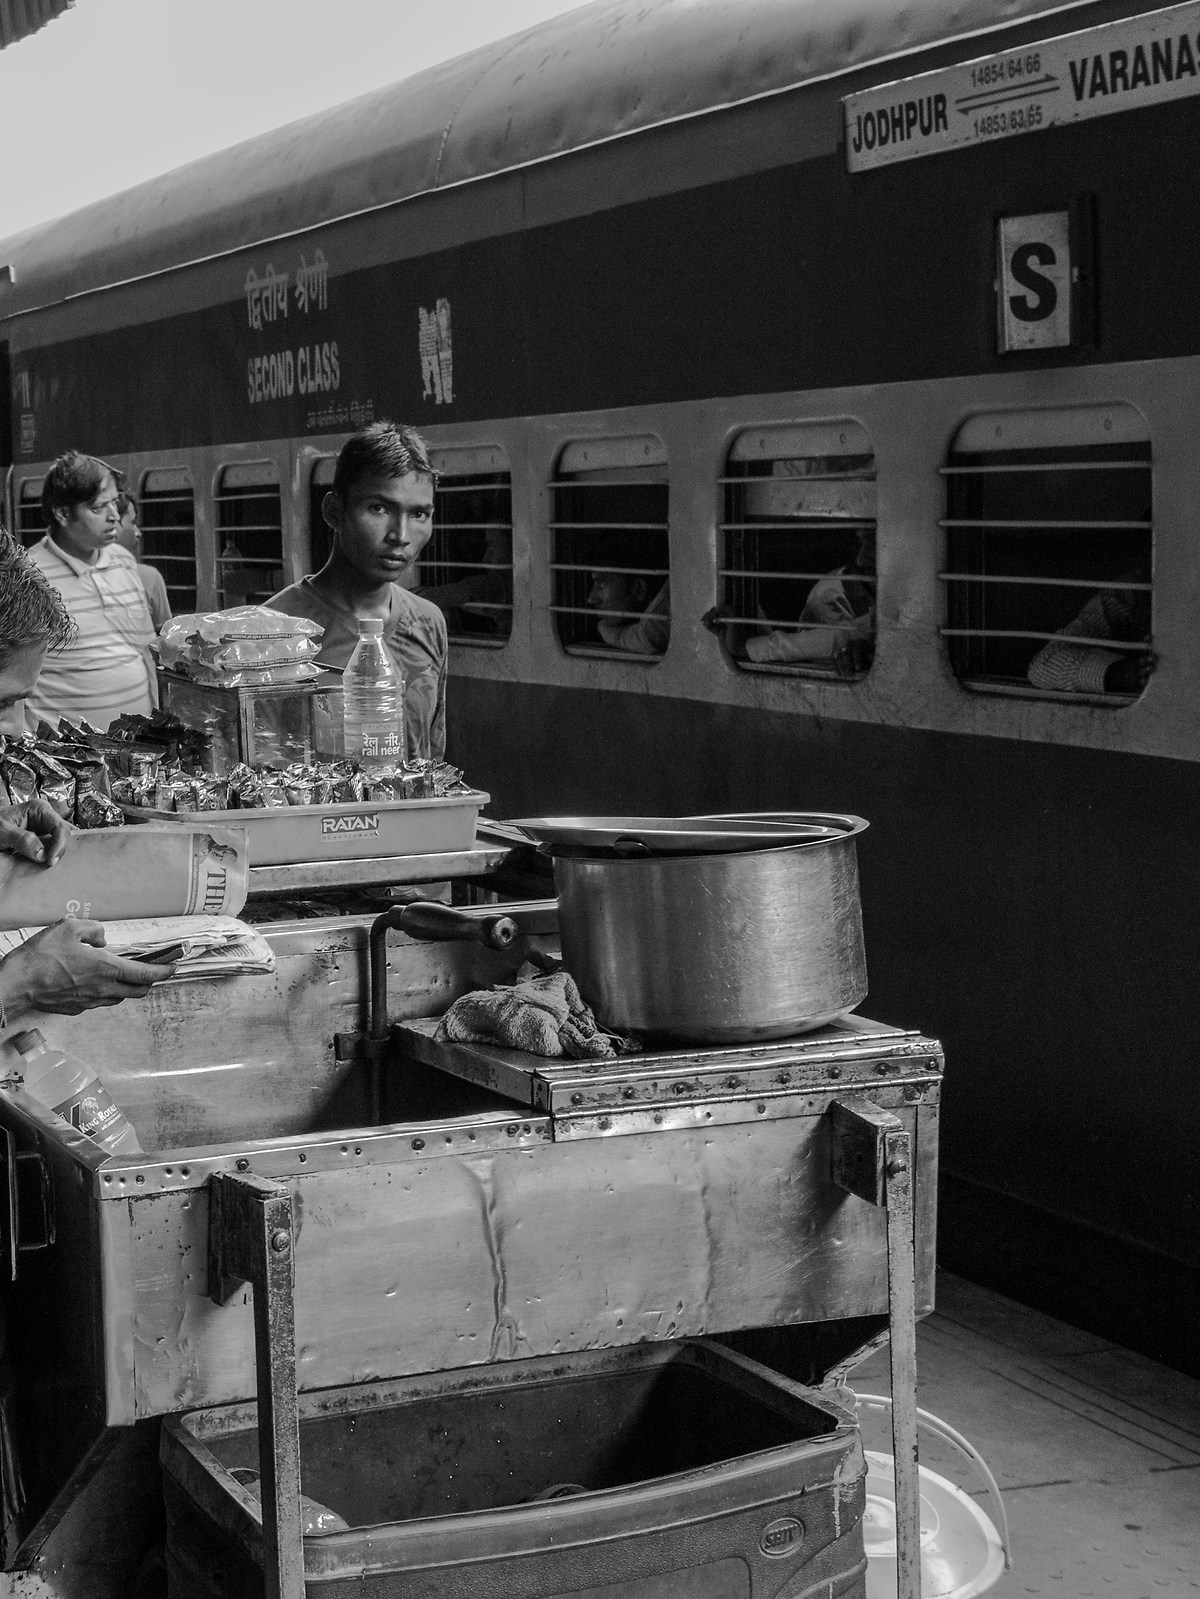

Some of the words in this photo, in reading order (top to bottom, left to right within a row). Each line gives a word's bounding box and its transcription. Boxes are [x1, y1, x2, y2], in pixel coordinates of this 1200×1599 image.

[970, 53, 1042, 88] 14854/64/66
[1069, 32, 1200, 101] VARANA
[852, 93, 949, 153] JODHPUR
[973, 104, 1043, 138] 14853/63/65
[1009, 242, 1058, 322] S
[248, 350, 294, 403] SECOND
[298, 341, 340, 395] CLASS
[362, 744, 379, 756] rail
[381, 745, 401, 756] neer
[322, 814, 379, 832] RATAN
